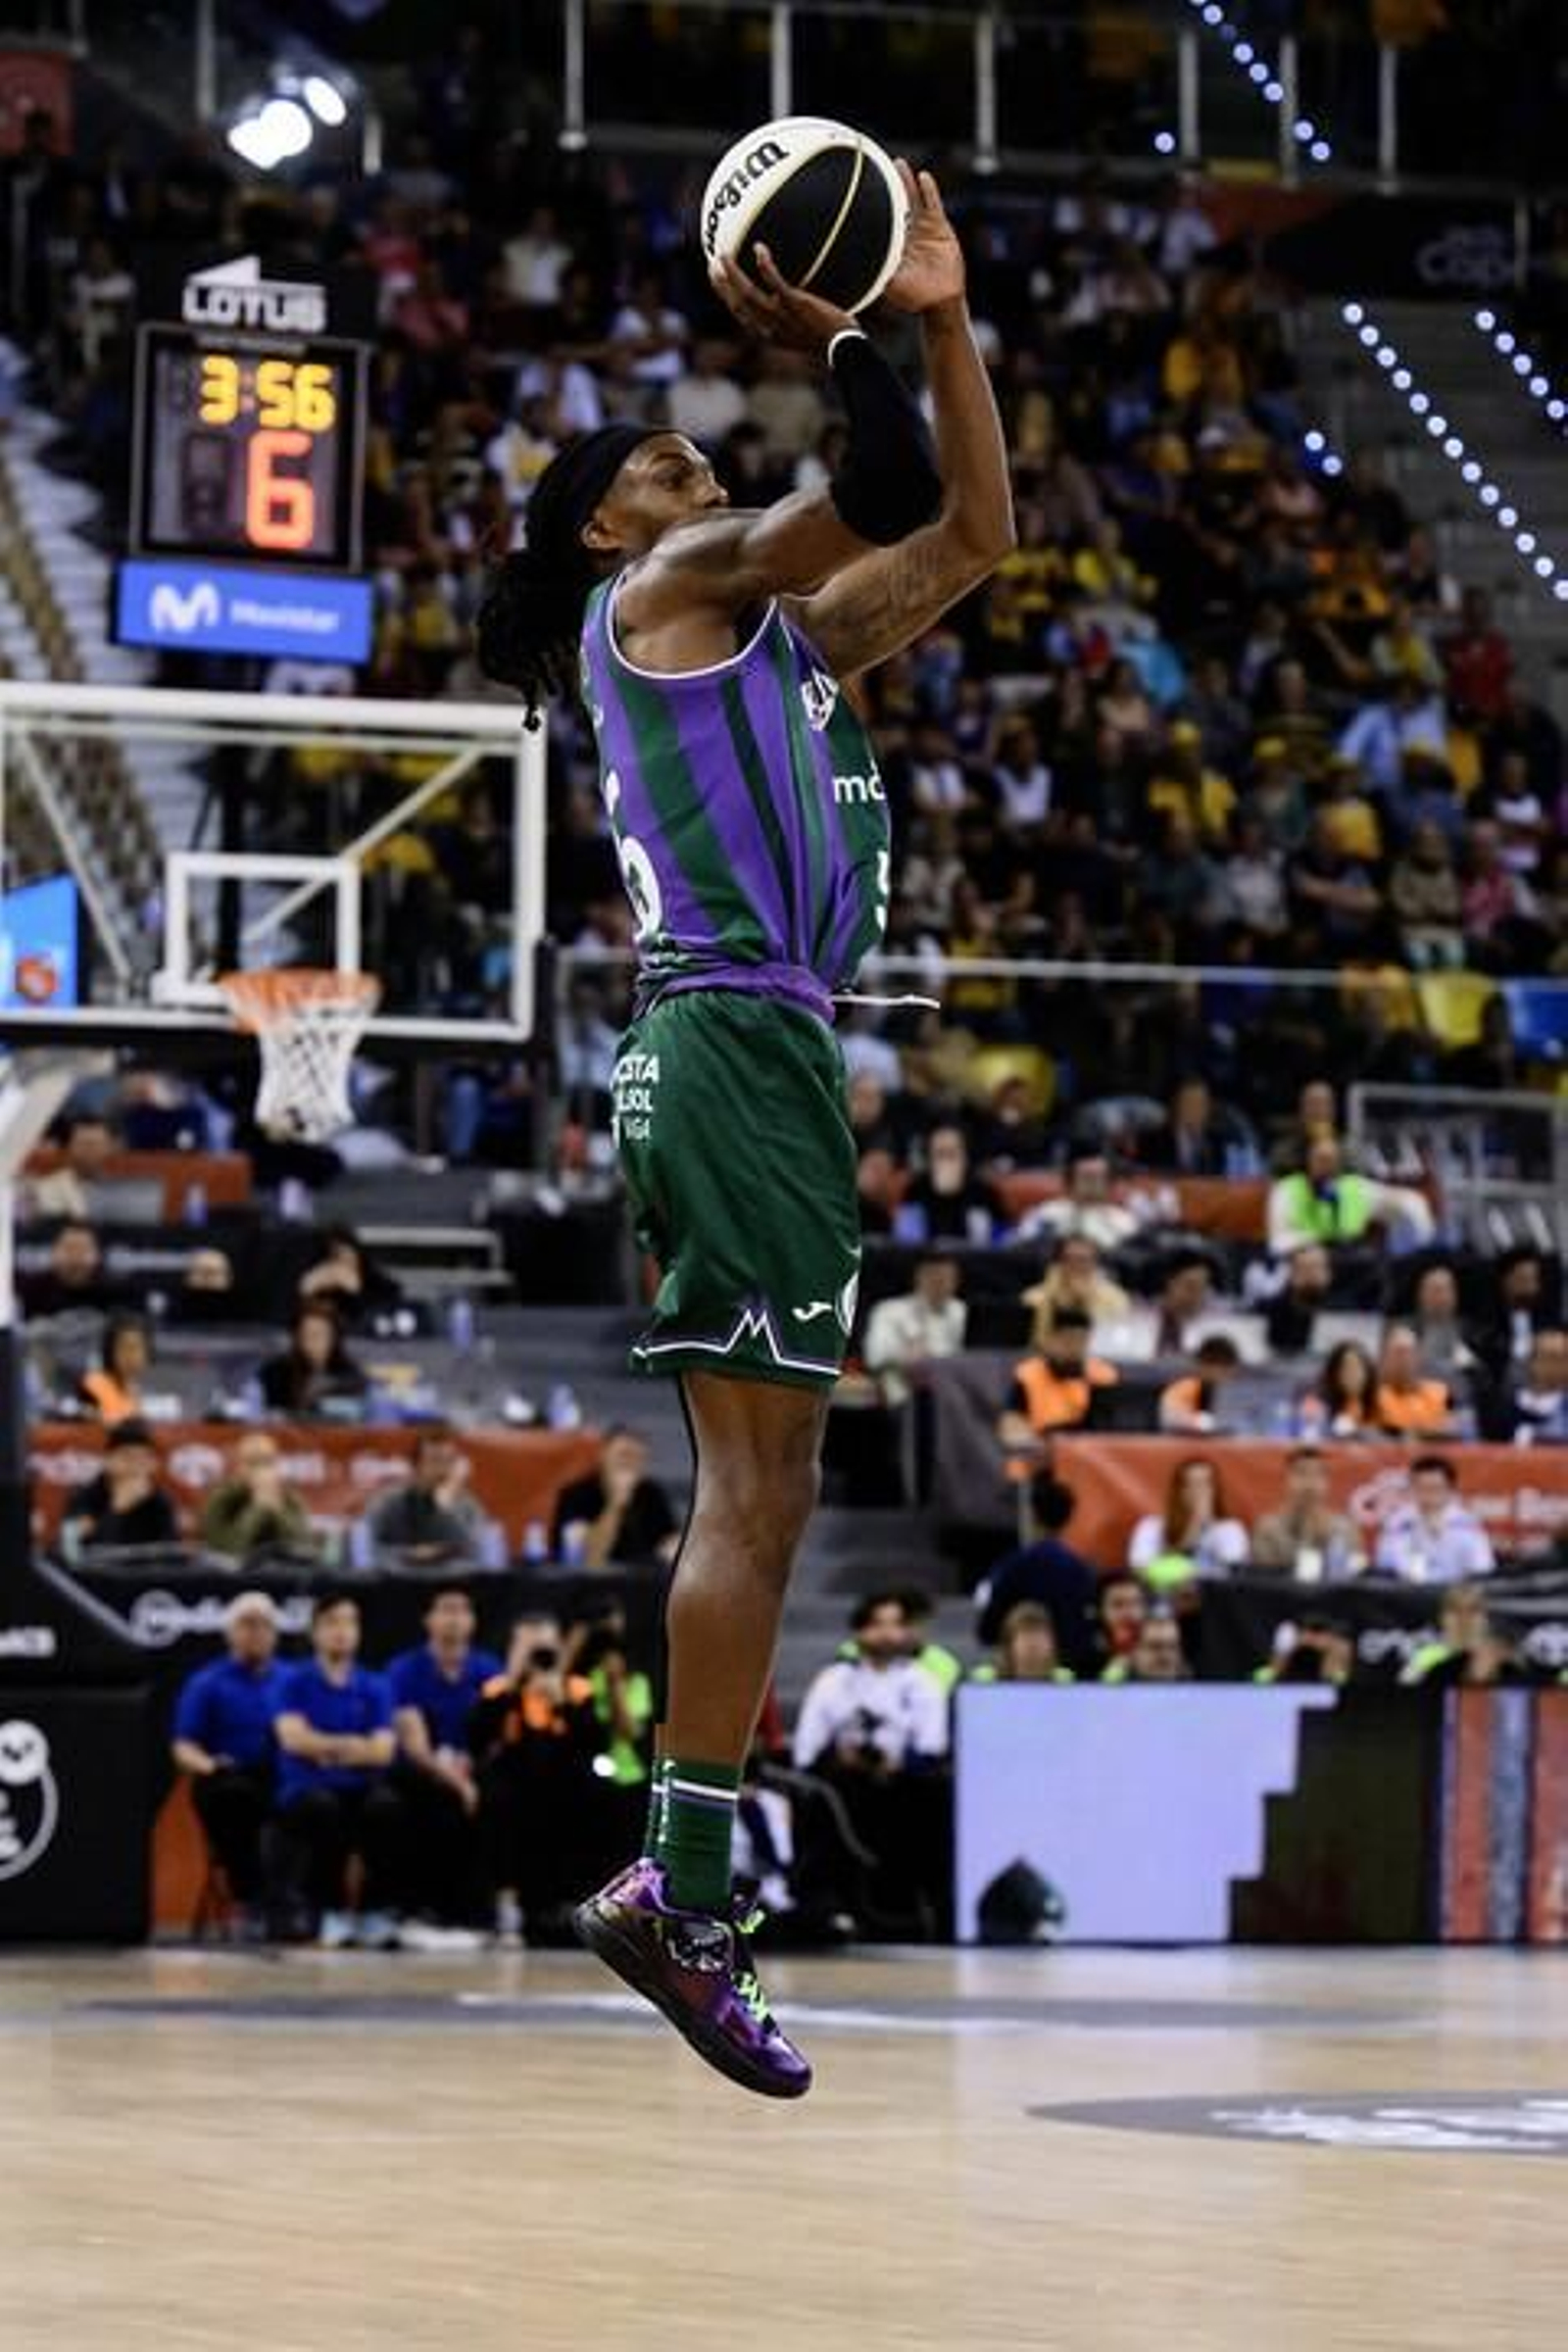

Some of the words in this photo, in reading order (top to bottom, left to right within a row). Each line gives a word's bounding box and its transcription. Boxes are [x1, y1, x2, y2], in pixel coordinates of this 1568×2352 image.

[183, 286, 325, 333] LOTUS
[200, 355, 336, 431] 3:56
[247, 429, 315, 550] 6
